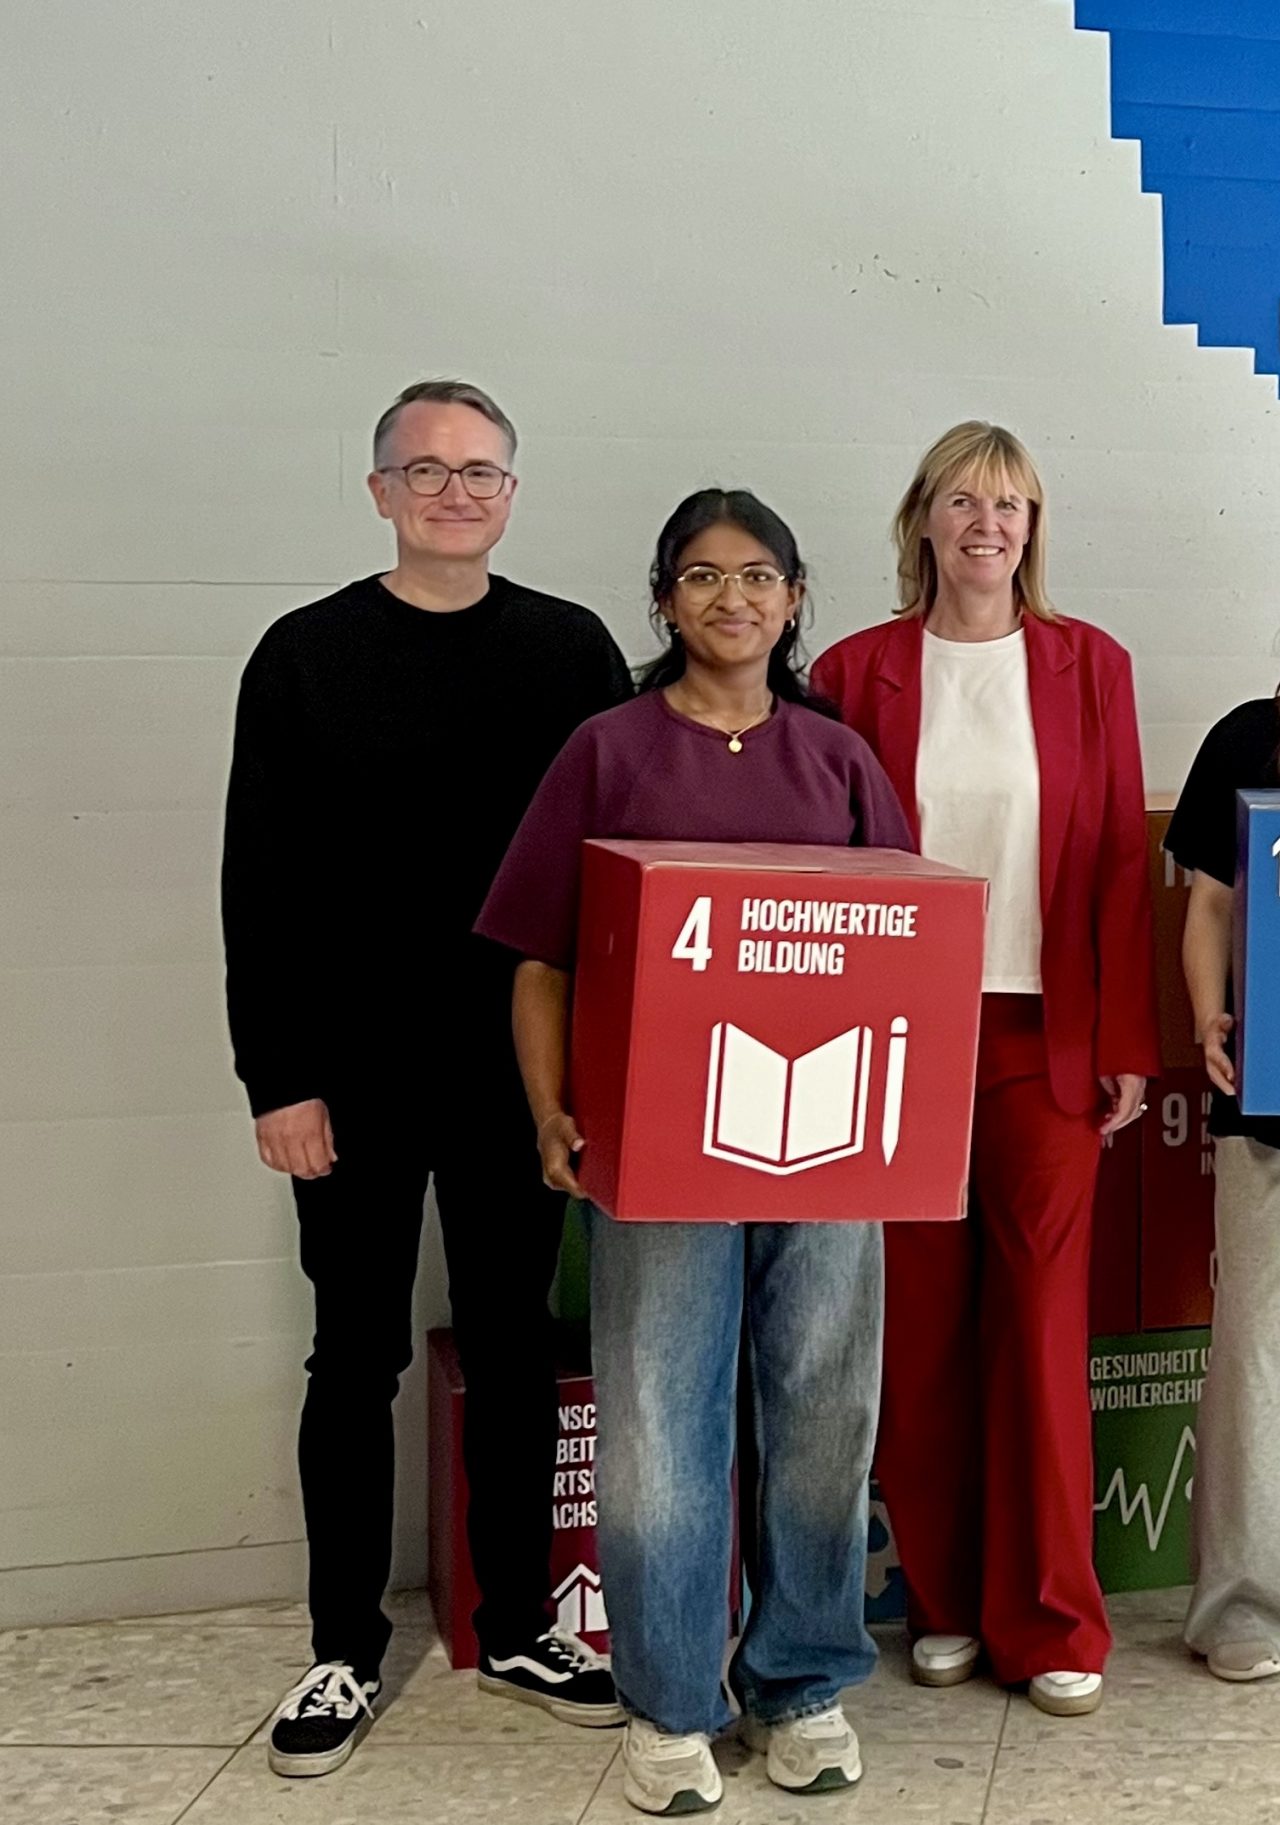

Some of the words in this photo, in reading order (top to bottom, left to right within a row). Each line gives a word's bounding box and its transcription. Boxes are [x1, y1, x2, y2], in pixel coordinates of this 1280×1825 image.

[671, 896, 713, 972] 4
[740, 898, 919, 938] HOCHWERTIGE
[737, 940, 845, 975] BILDUNG
[1162, 1092, 1188, 1147] 9
[1090, 1348, 1198, 1381] GESUNDHEIT
